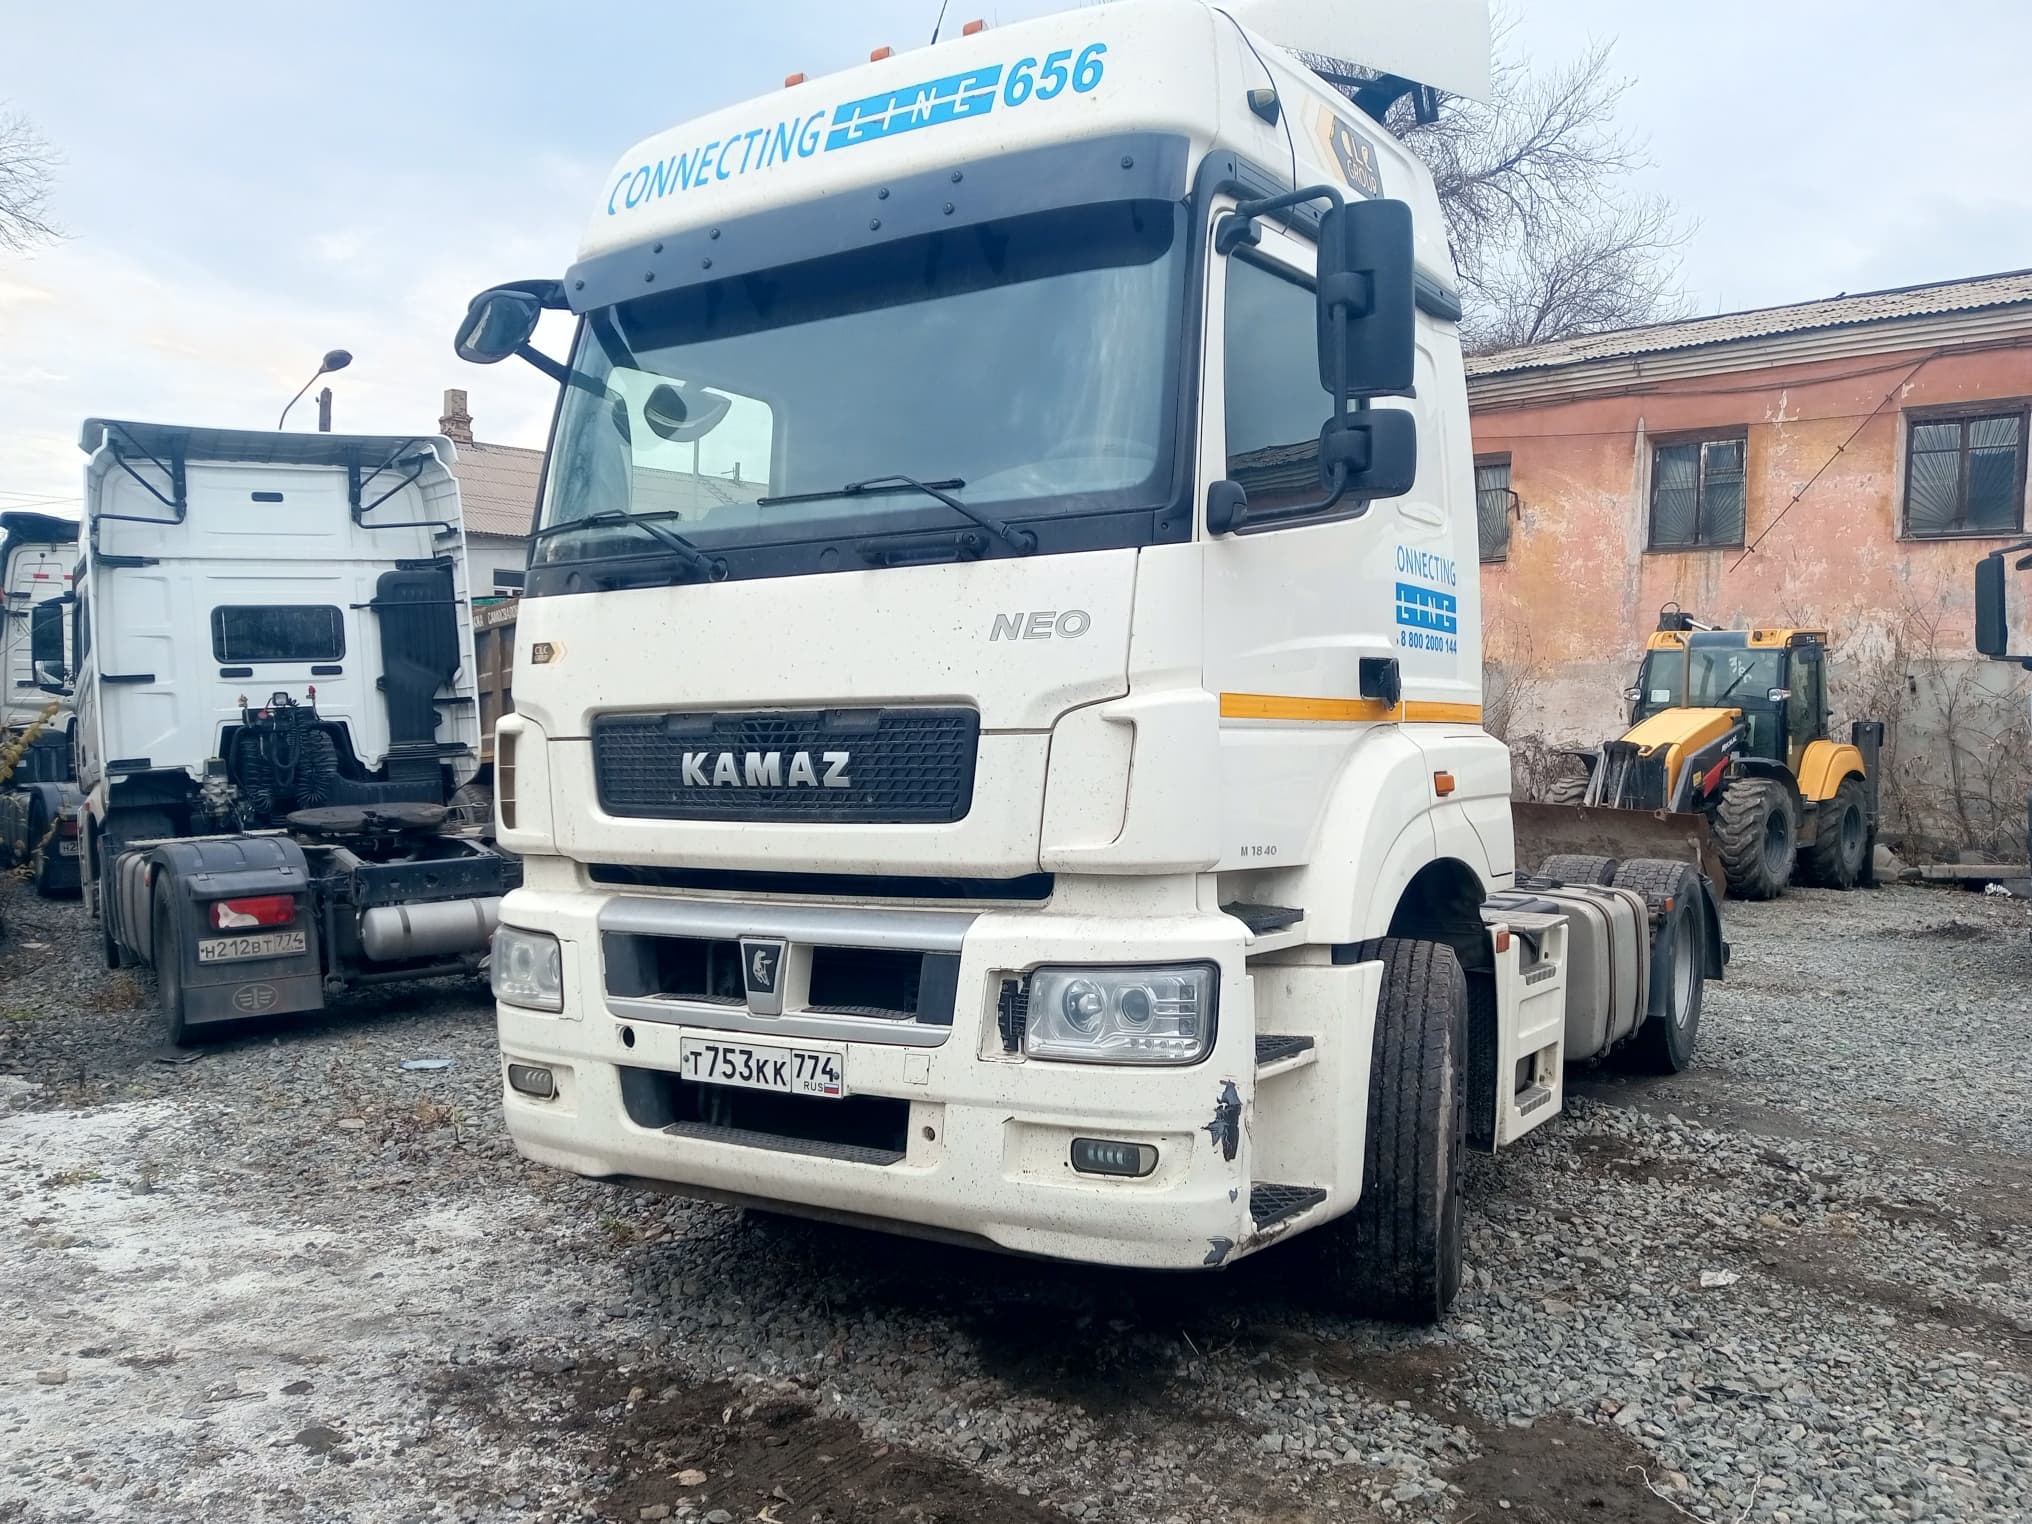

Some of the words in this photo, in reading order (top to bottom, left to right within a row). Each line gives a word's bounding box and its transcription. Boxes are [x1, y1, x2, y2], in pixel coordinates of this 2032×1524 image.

[608, 109, 826, 215] CONNECTING
[841, 74, 983, 142] LINE
[1003, 42, 1108, 107] 656
[1395, 544, 1456, 587] ONNECTING
[1399, 587, 1451, 628] LINE
[989, 609, 1091, 641] NEO
[1401, 630, 1406, 646] 8
[1408, 632, 1423, 648] 800
[1425, 634, 1444, 652] 2000
[682, 751, 851, 787] KAMAZ
[1240, 846, 1248, 856] M
[794, 1053, 835, 1082] 774
[803, 1081, 824, 1092] RUS
